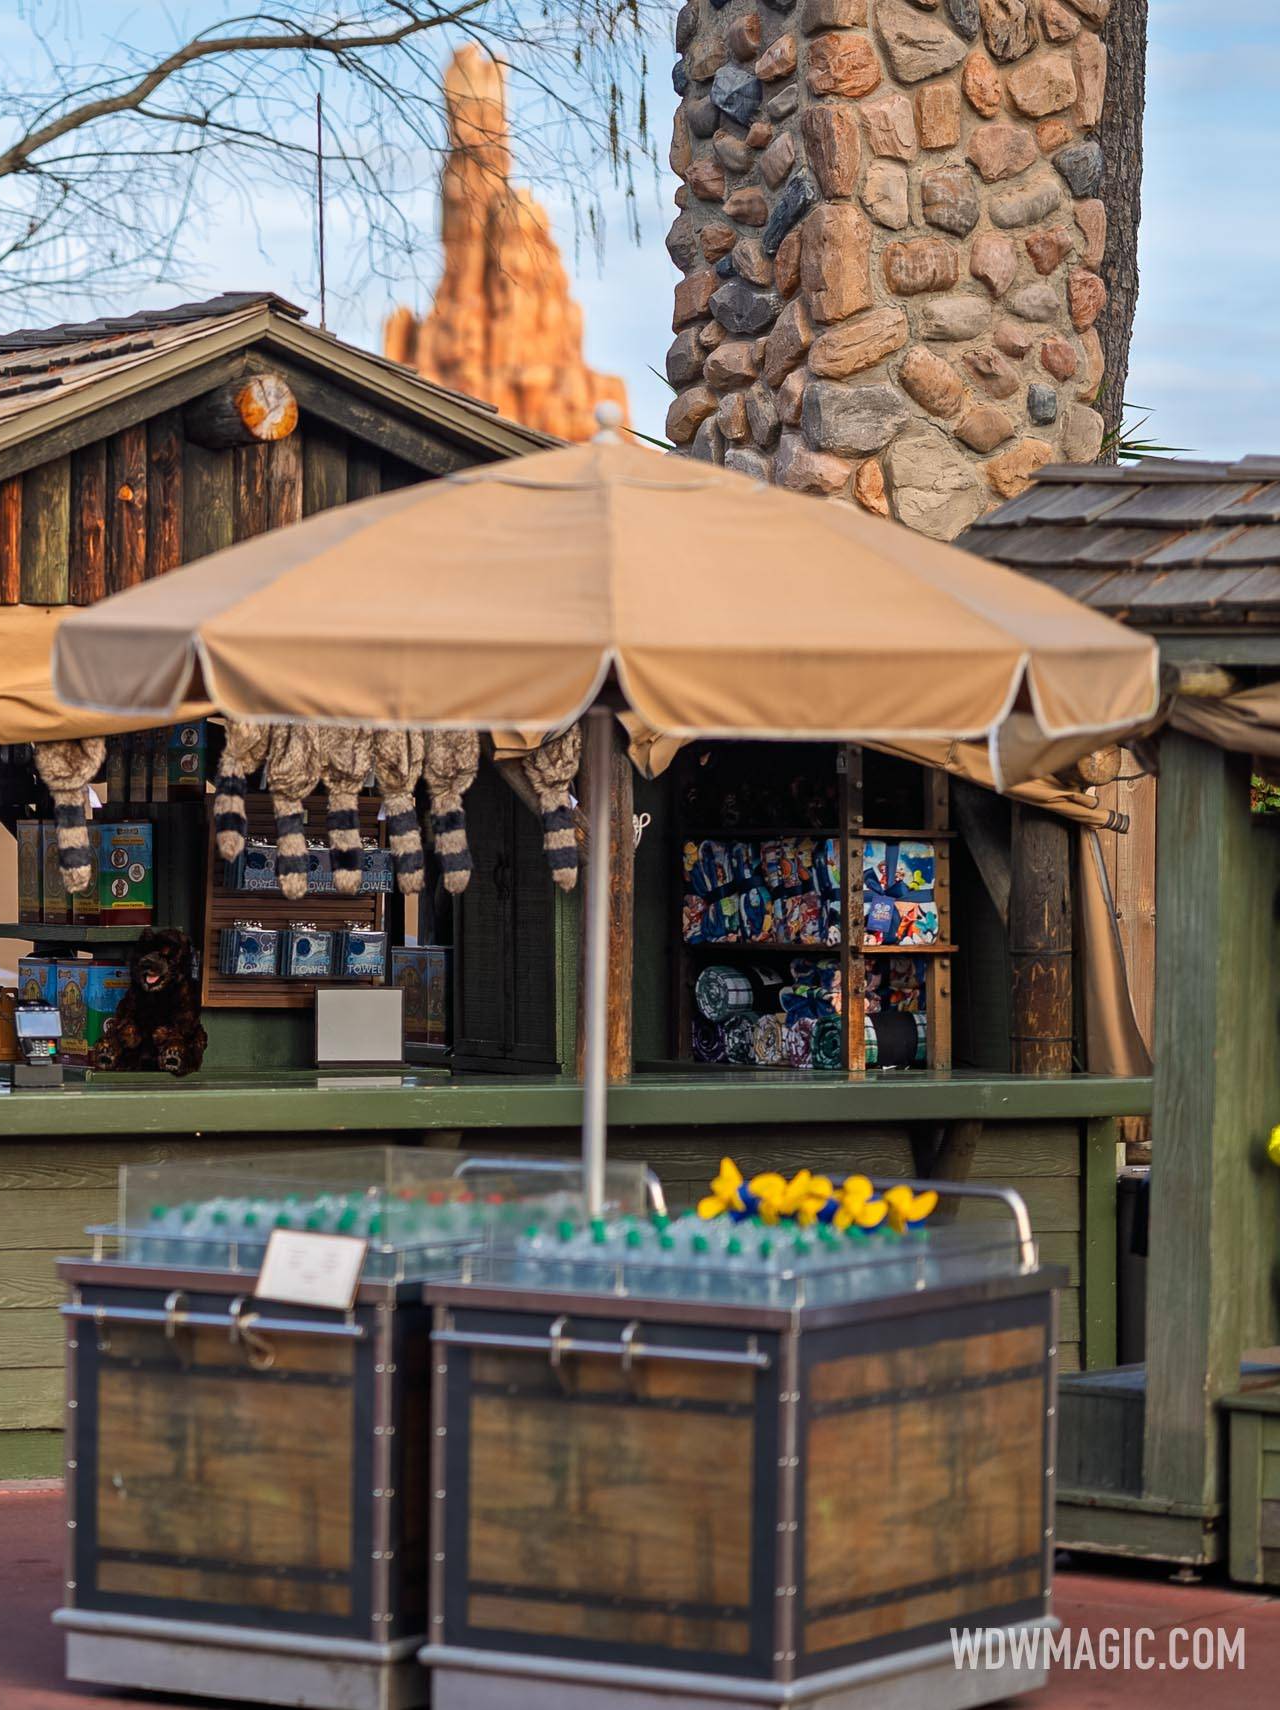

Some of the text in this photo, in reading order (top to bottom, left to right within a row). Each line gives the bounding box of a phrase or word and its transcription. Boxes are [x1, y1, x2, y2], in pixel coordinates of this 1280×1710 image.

[308, 881, 336, 890] OWEL
[361, 881, 391, 891] OWEL
[347, 965, 383, 974] TOWEL
